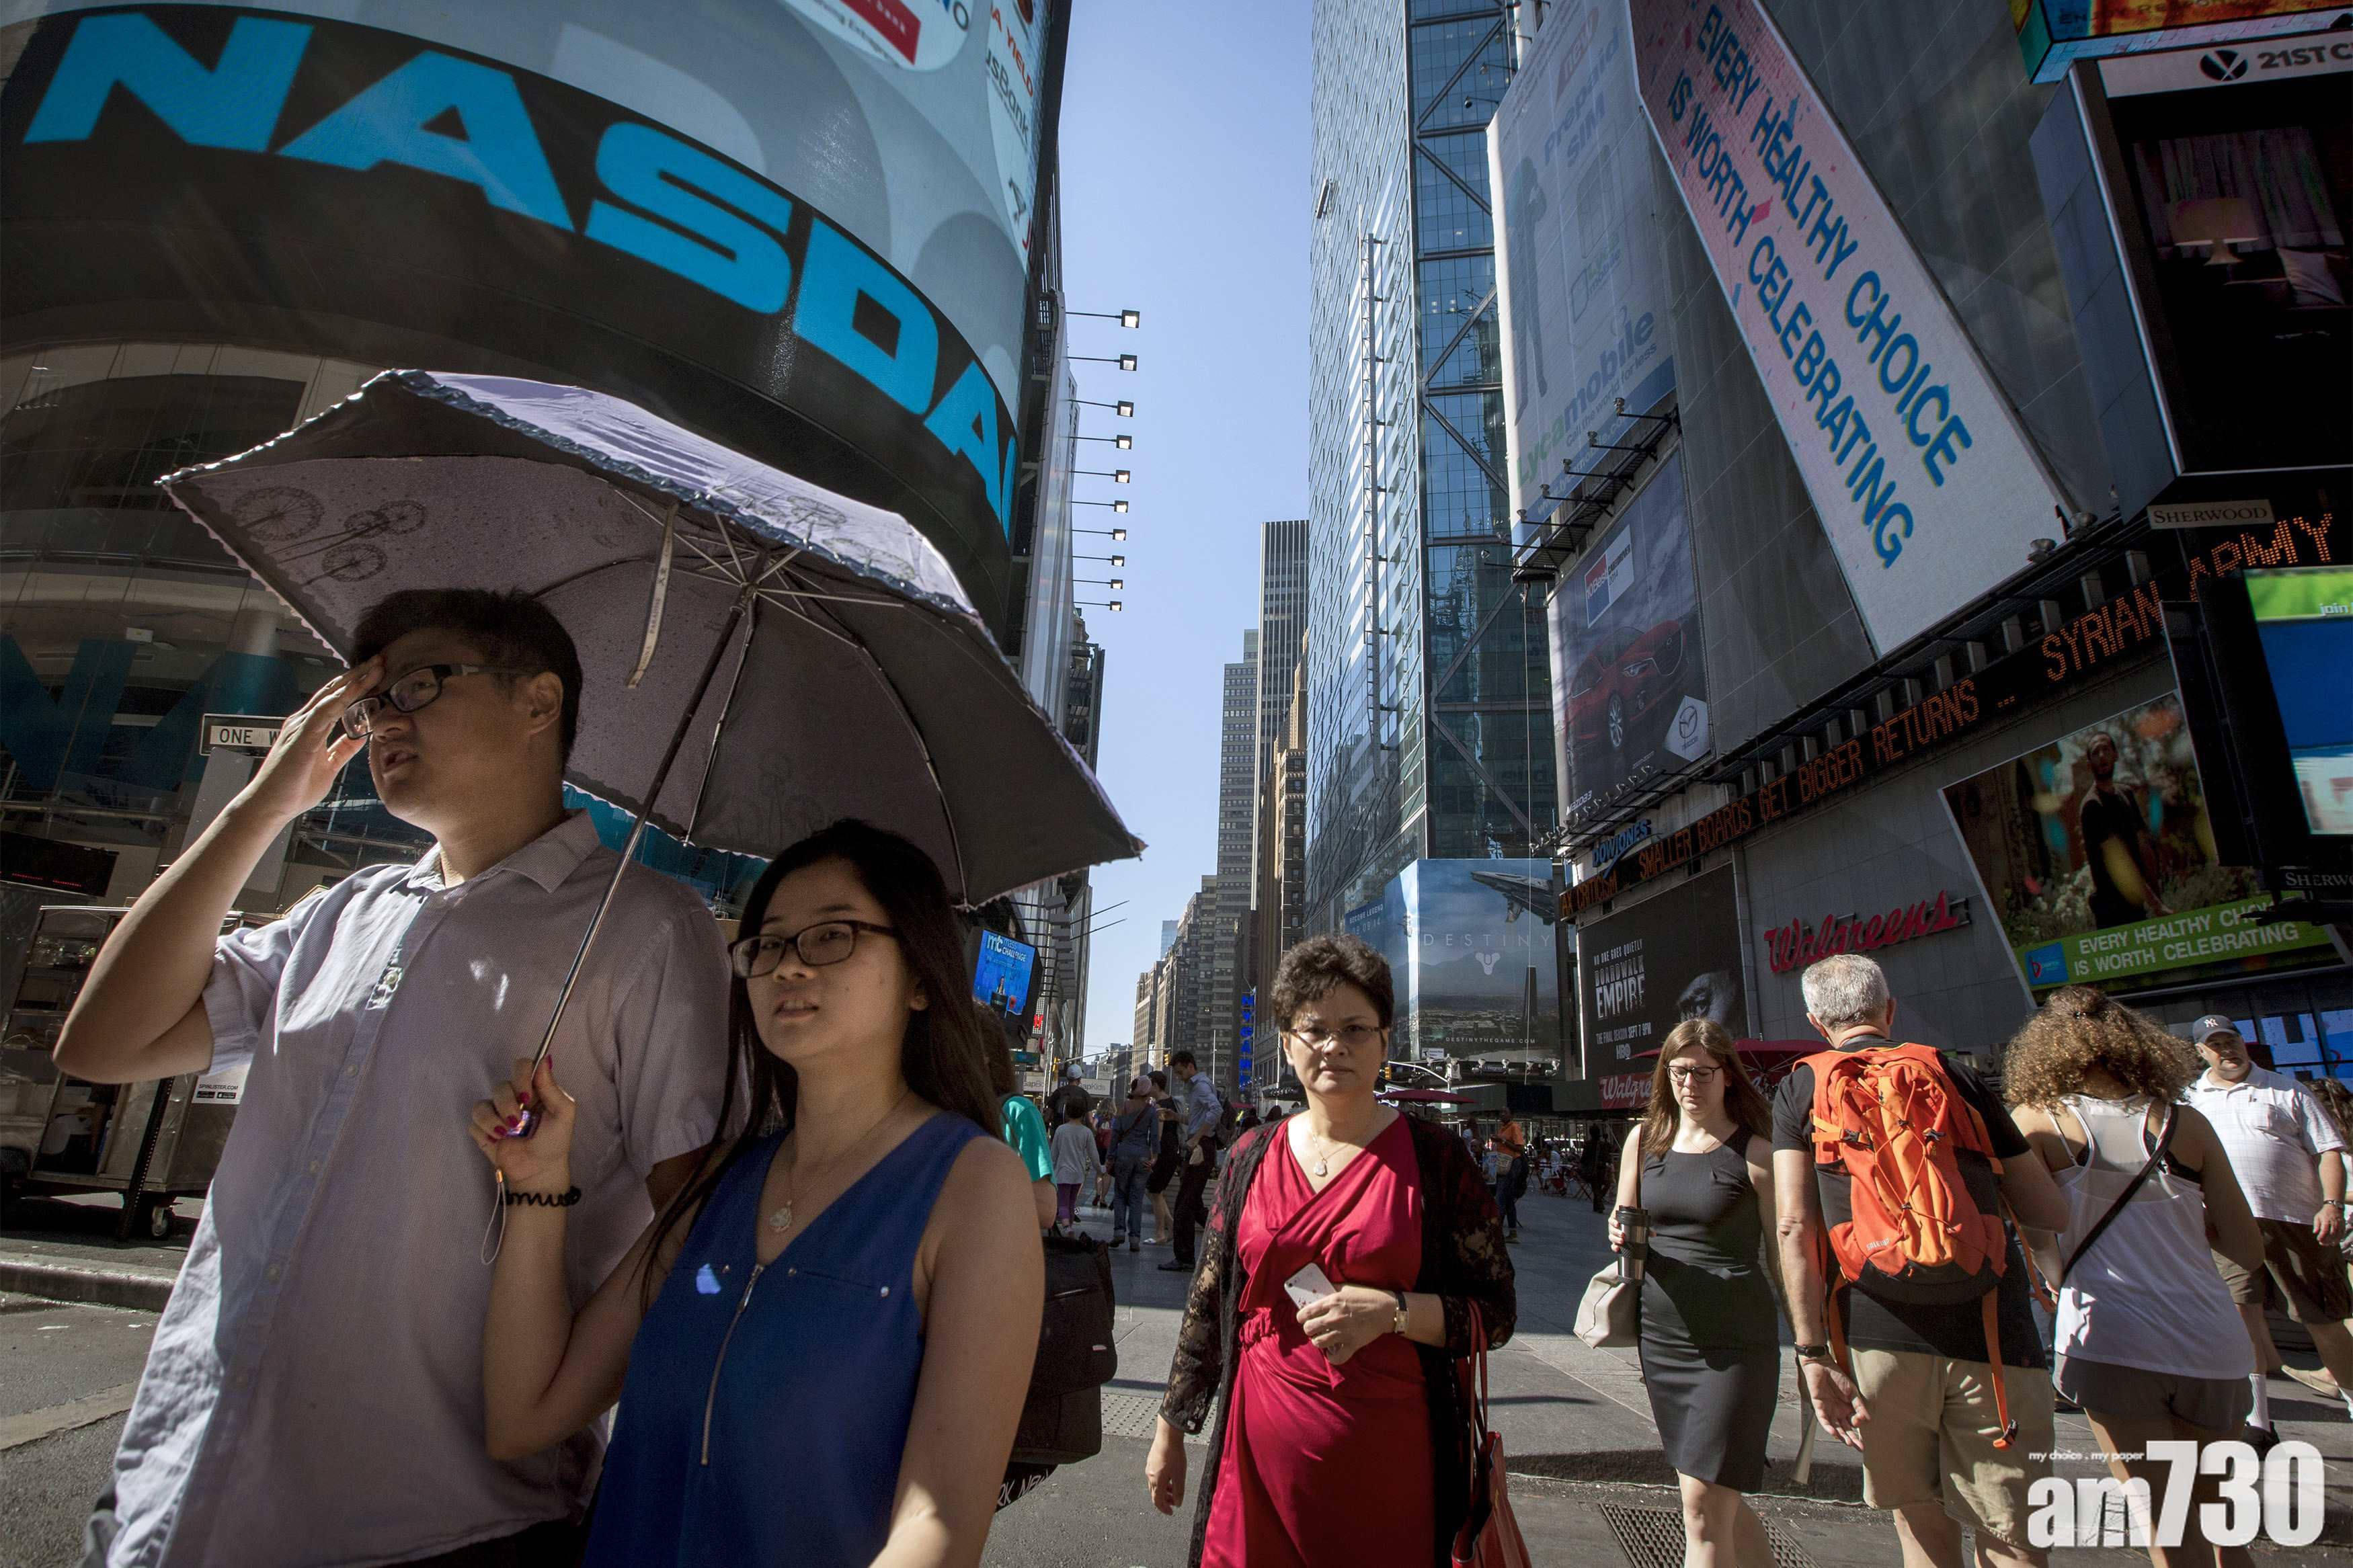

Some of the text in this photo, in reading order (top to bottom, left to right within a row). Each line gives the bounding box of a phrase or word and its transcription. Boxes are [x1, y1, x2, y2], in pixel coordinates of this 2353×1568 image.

[2257, 45, 2326, 69] 21ST
[1698, 4, 1972, 487] EVERY HEALTHY CHOICE
[23, 13, 1017, 549] NASDA
[1669, 69, 1914, 569] IS WORTH CELEBRATING
[2151, 508, 2268, 525] SHERWOOD
[2319, 602, 2348, 616] join
[219, 728, 253, 745] ONE
[1638, 827, 1693, 879] SMALLER
[1698, 797, 1752, 852] BOARDS
[1759, 775, 1789, 821] GET
[1798, 739, 1865, 804] BIGGER
[1871, 677, 1980, 768] RETURNS
[2040, 579, 2165, 683] SYRIAN
[1423, 934, 1550, 947] DESTINY
[1763, 891, 1958, 974] Walgreens
[2079, 930, 2128, 955] EVERY
[2134, 913, 2212, 942] HEALTHY
[1002, 946, 1027, 962] CHALLENGE
[1601, 951, 1610, 964] ONE
[1611, 946, 1622, 960] GOES
[2074, 959, 2089, 977] IS
[2095, 946, 2156, 969] WORTH
[2163, 921, 2299, 962] CELEBRATING
[1594, 954, 1645, 987] BOARDWALK
[1595, 974, 1646, 1021] EMPIRE
[1445, 1036, 1536, 1045] DESTINYTHEGAME.COM
[1628, 1024, 1638, 1039] SEPT
[1616, 1043, 1631, 1060] HBO
